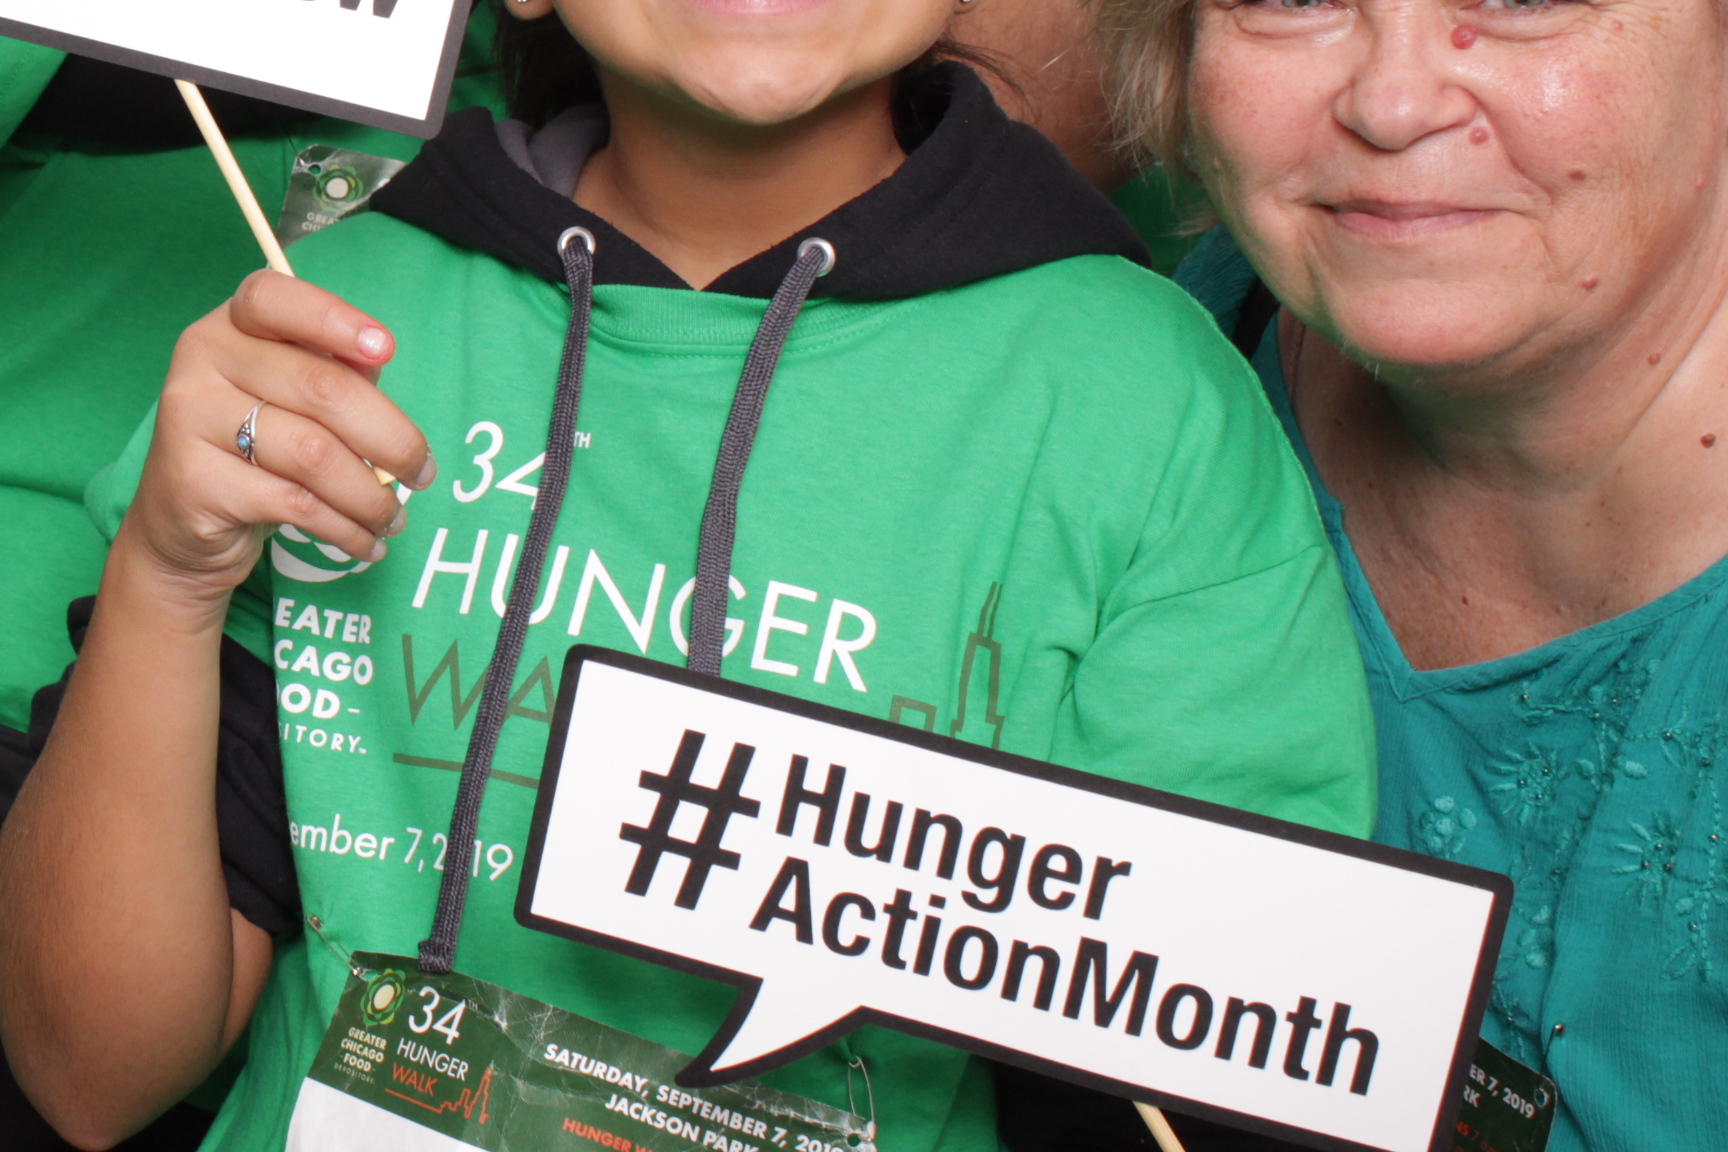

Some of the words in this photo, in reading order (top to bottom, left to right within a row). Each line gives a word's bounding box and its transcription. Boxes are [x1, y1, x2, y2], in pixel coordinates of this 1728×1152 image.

[306, 212, 340, 225] GREA
[275, 597, 371, 644] EATER
[411, 527, 877, 693] HUNGER
[274, 639, 373, 685] CAGO
[402, 633, 557, 730] WA
[276, 680, 341, 719] OD
[289, 813, 395, 860] ember
[432, 833, 514, 881] 219
[748, 855, 1380, 1097] ActionMonth
[340, 1038, 384, 1063] CHICAGO
[348, 1026, 387, 1050] GREATER
[396, 1037, 469, 1081] HUNGER
[343, 1053, 371, 1073] FOOD
[391, 1062, 439, 1096] WALK
[544, 1043, 650, 1098] SATURDAY,
[656, 1084, 768, 1140] SEPTEMBER
[772, 1126, 788, 1149] 7,
[604, 1094, 700, 1143] JACKSON
[1502, 1087, 1535, 1119] 2019
